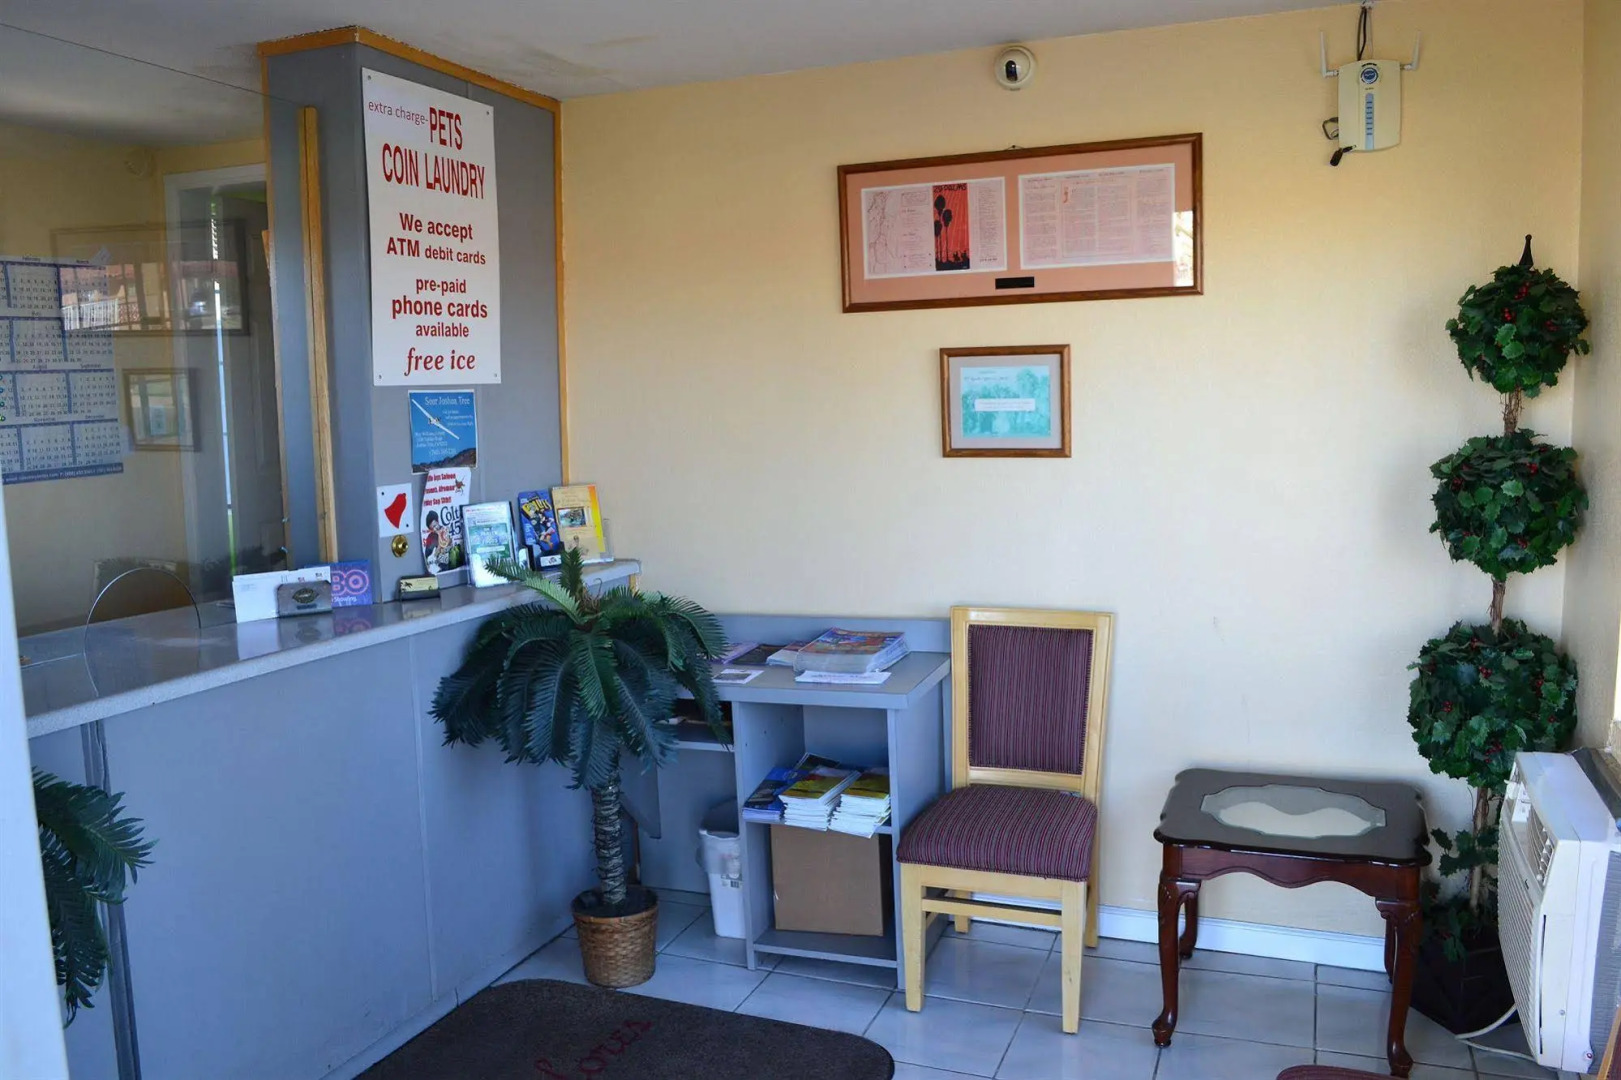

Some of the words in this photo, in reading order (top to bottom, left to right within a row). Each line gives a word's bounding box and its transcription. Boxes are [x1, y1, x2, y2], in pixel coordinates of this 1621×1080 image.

[368, 101, 393, 116] extra
[429, 106, 463, 150] PETS
[382, 143, 419, 187] COIN
[424, 152, 485, 199] LAUNDRY
[399, 212, 423, 233] We
[427, 220, 473, 243] accept
[386, 236, 420, 257] ATM
[425, 245, 453, 262] debit
[456, 250, 486, 265] cards
[416, 278, 467, 296] pre-paid
[391, 295, 443, 319] phone
[447, 300, 488, 318] cards
[415, 322, 470, 338] available
[404, 347, 444, 376] free
[450, 349, 476, 370] ice
[438, 396, 457, 406] Joshua
[458, 396, 470, 405] Tree
[440, 505, 460, 526] Colt
[449, 521, 461, 536] 45
[331, 569, 369, 596] BO
